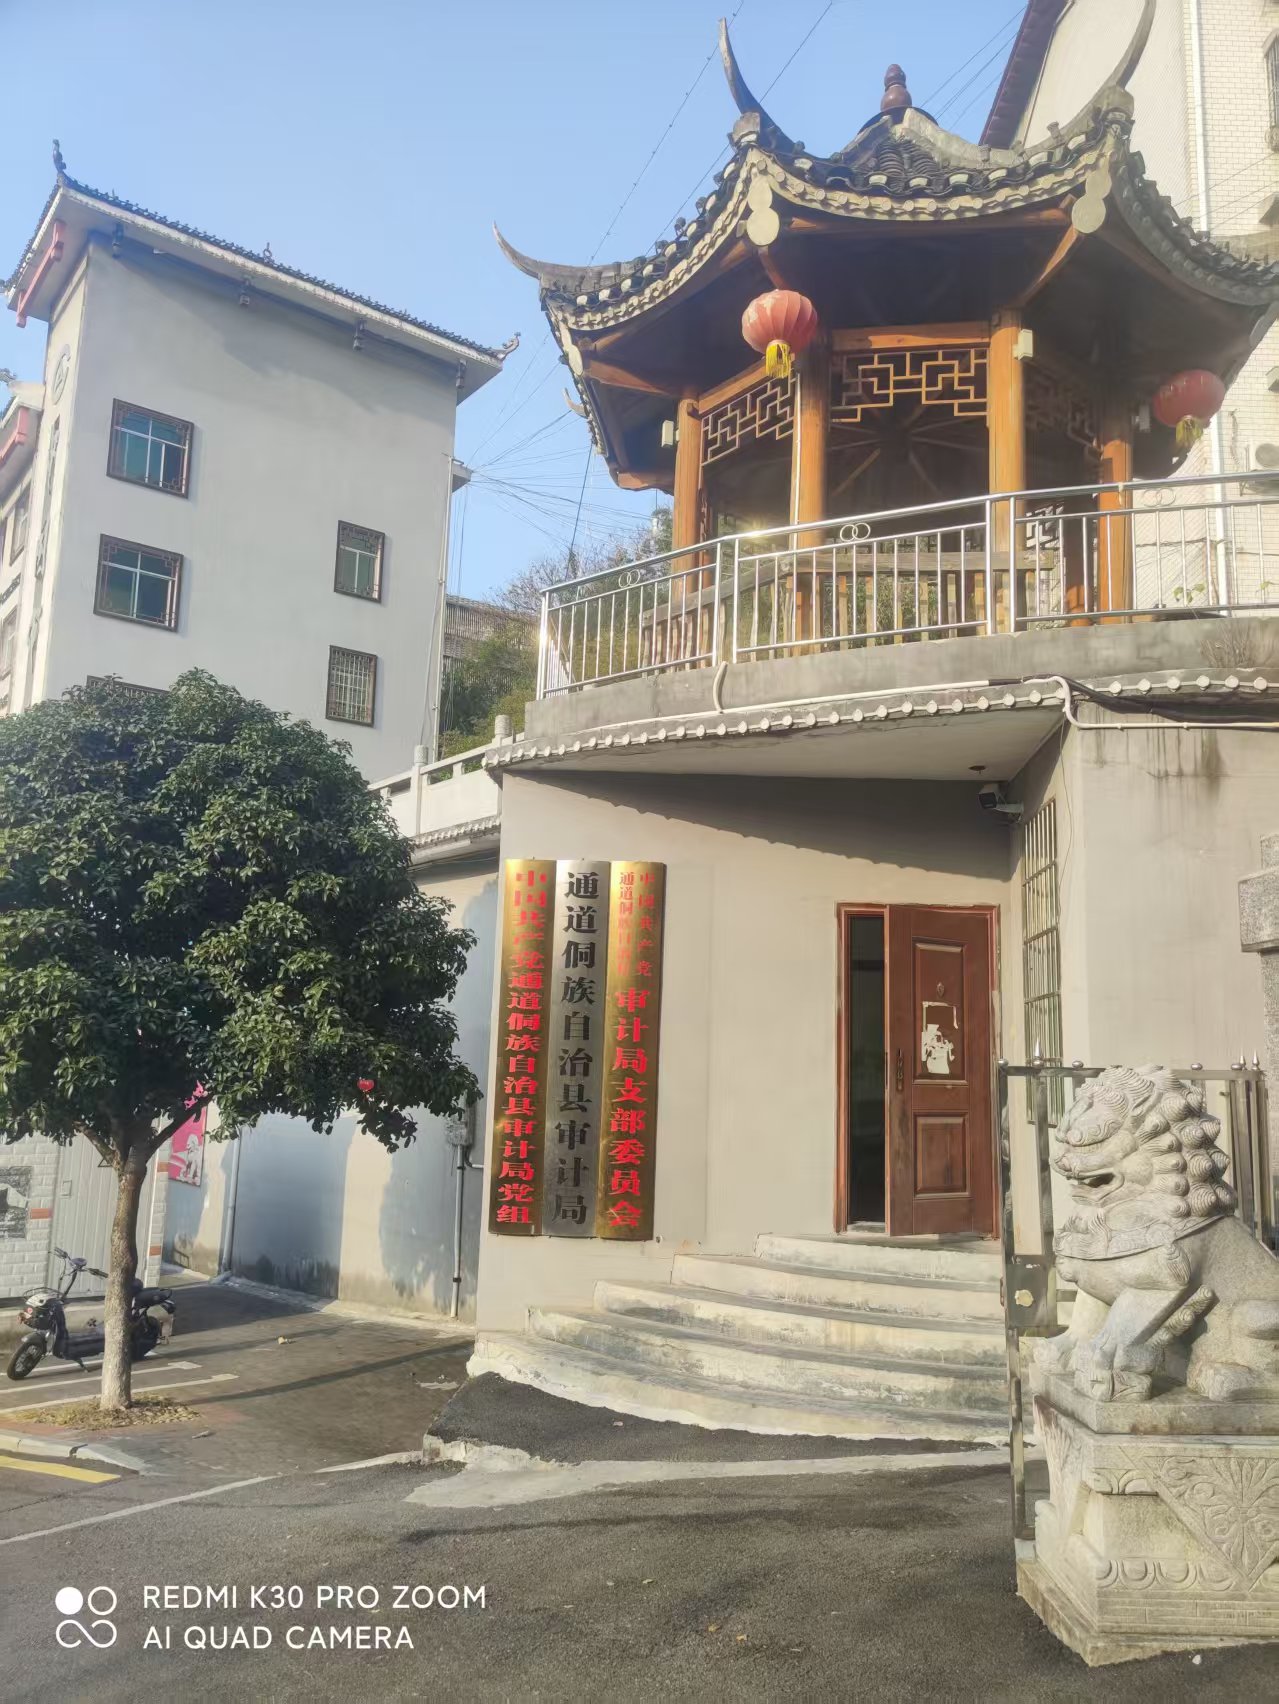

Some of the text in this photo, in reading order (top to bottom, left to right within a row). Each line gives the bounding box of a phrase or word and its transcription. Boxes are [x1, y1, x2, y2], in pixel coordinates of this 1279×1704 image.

[552, 871, 600, 1225] 通道侗族自治县审计局
[607, 987, 650, 1228] 审计局支部委员会
